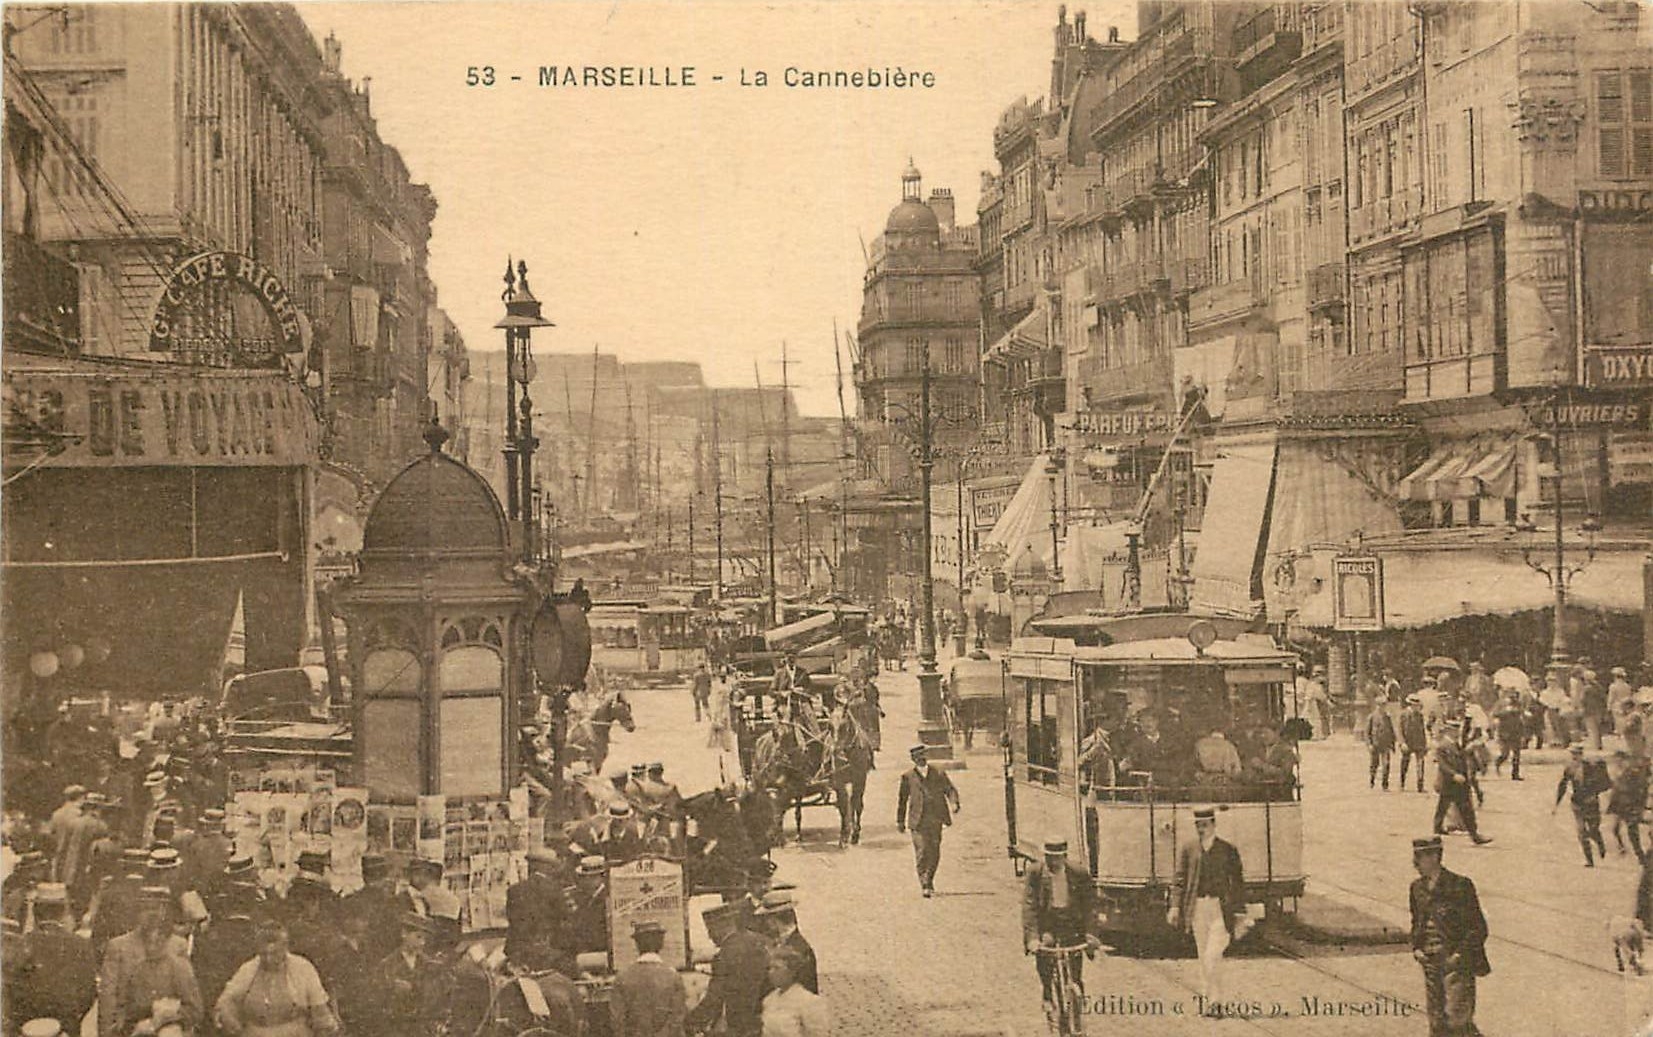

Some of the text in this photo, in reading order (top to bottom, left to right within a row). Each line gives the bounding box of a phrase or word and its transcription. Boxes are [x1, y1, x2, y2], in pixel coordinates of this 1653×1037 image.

[236, 254, 302, 342] RICHE
[88, 389, 145, 457] DE
[1545, 404, 1639, 423] OUVRIERS
